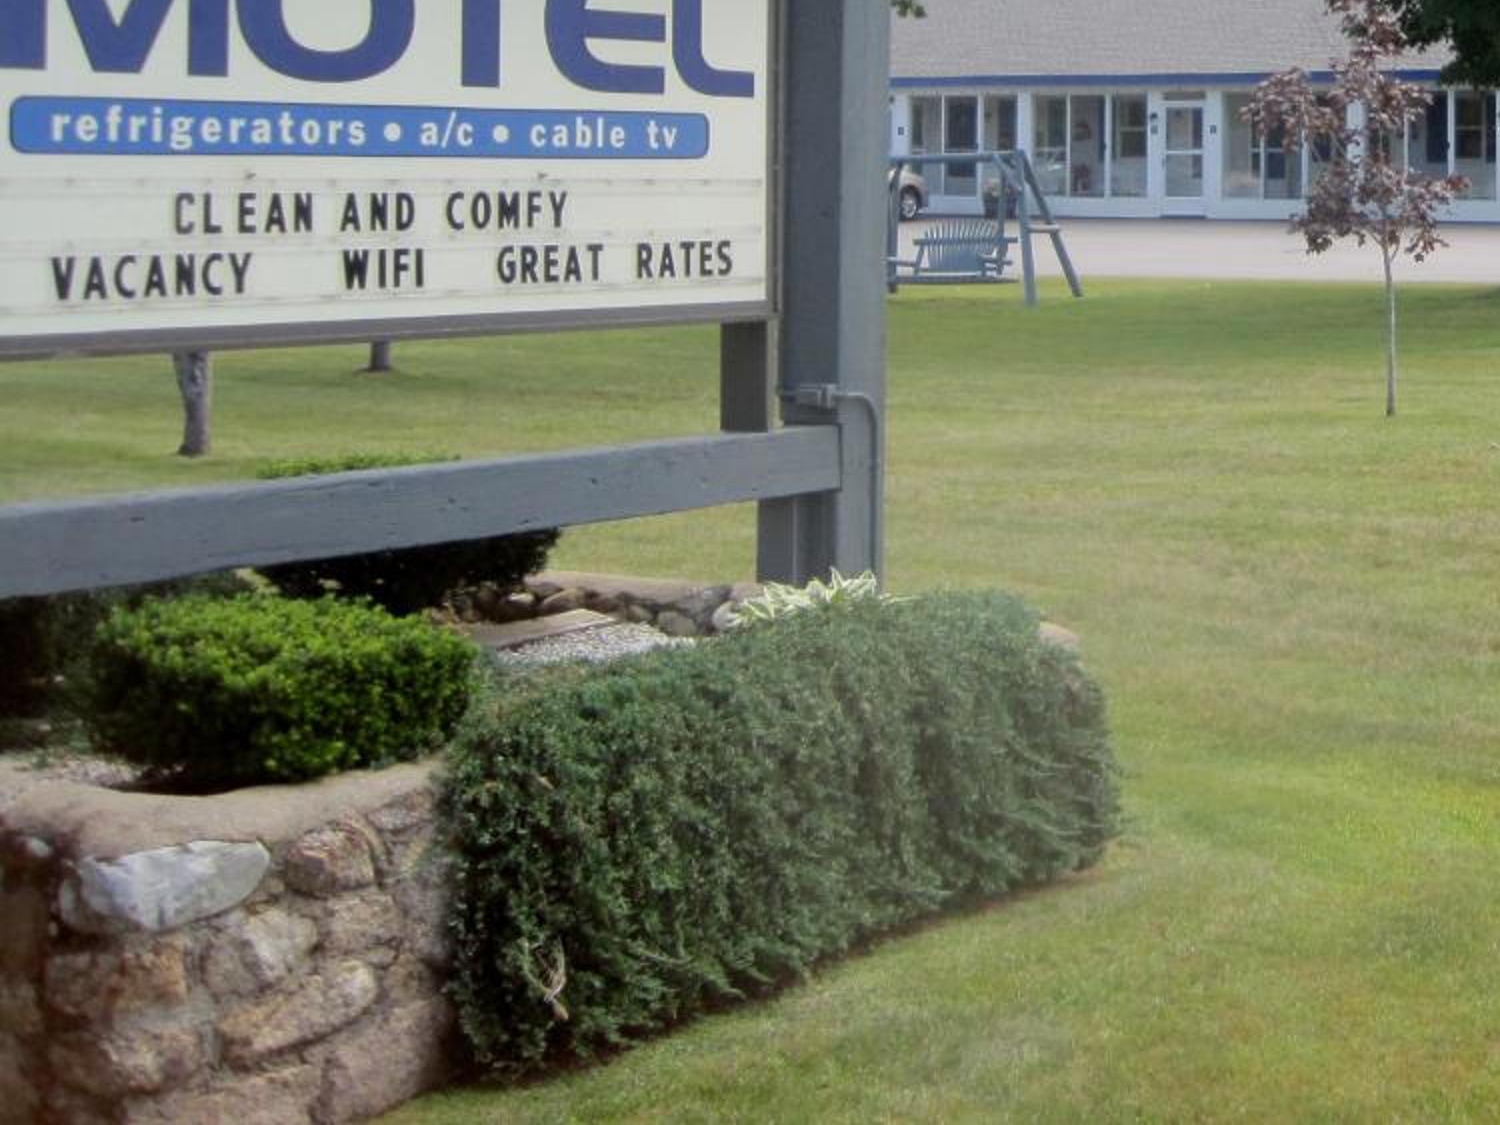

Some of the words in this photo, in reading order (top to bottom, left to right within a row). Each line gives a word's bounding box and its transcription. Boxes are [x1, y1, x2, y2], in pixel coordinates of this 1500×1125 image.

[51, 105, 367, 150] refrigerators
[420, 111, 474, 149] a/c
[529, 117, 626, 149] cable
[647, 120, 678, 149] tv
[174, 192, 312, 235] CLEAN
[340, 191, 415, 232] AND
[445, 190, 568, 231] COMFY
[51, 252, 253, 300] VACANCY
[343, 248, 424, 290] WIFI
[497, 243, 604, 284] GREAT
[636, 239, 733, 280] RATES
